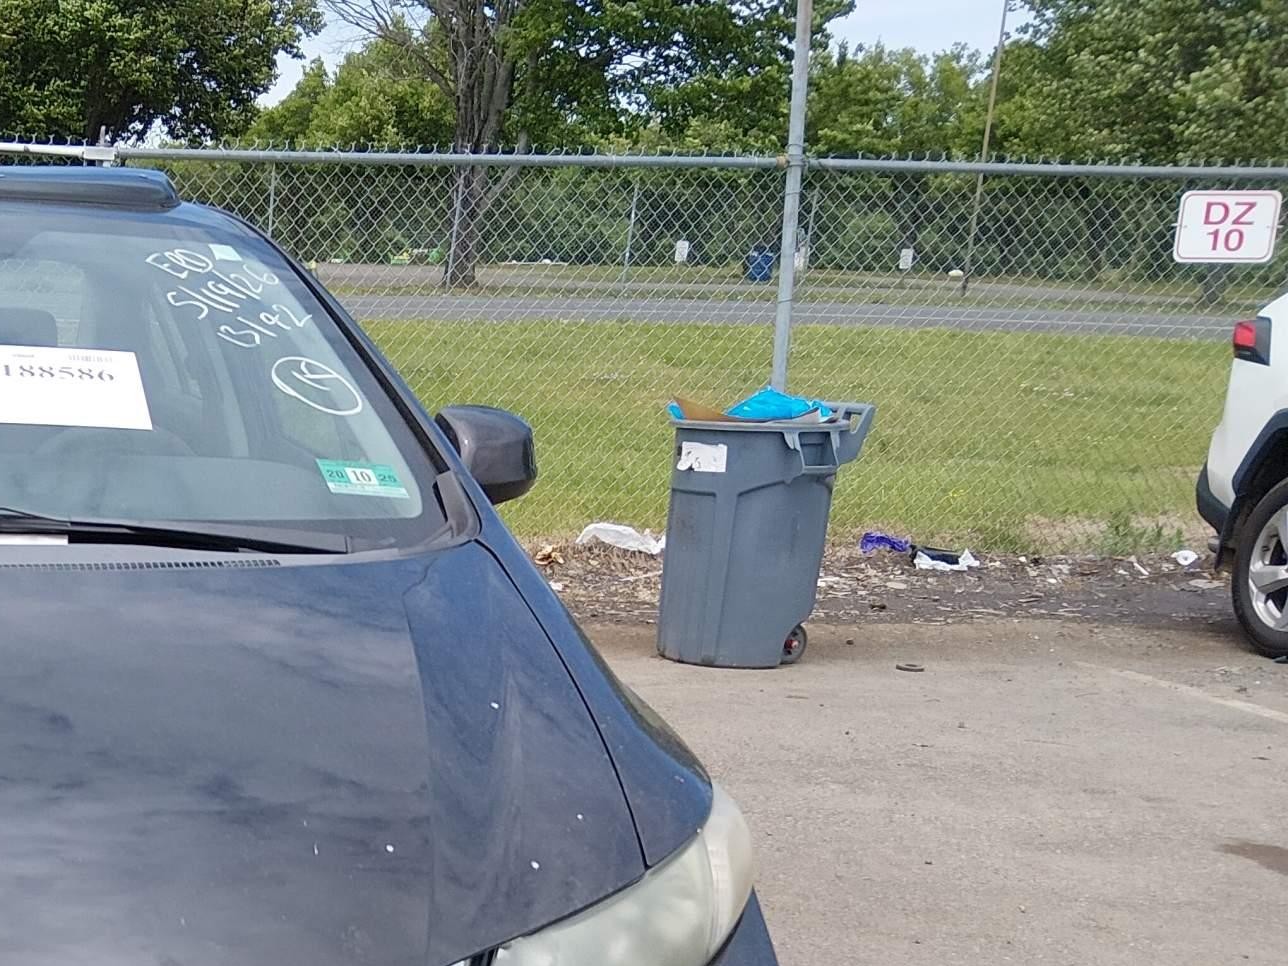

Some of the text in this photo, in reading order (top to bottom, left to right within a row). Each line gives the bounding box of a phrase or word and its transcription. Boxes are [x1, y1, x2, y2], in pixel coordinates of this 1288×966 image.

[1203, 201, 1257, 226] DZ
[1206, 228, 1245, 252] 10
[351, 469, 372, 483] 10
